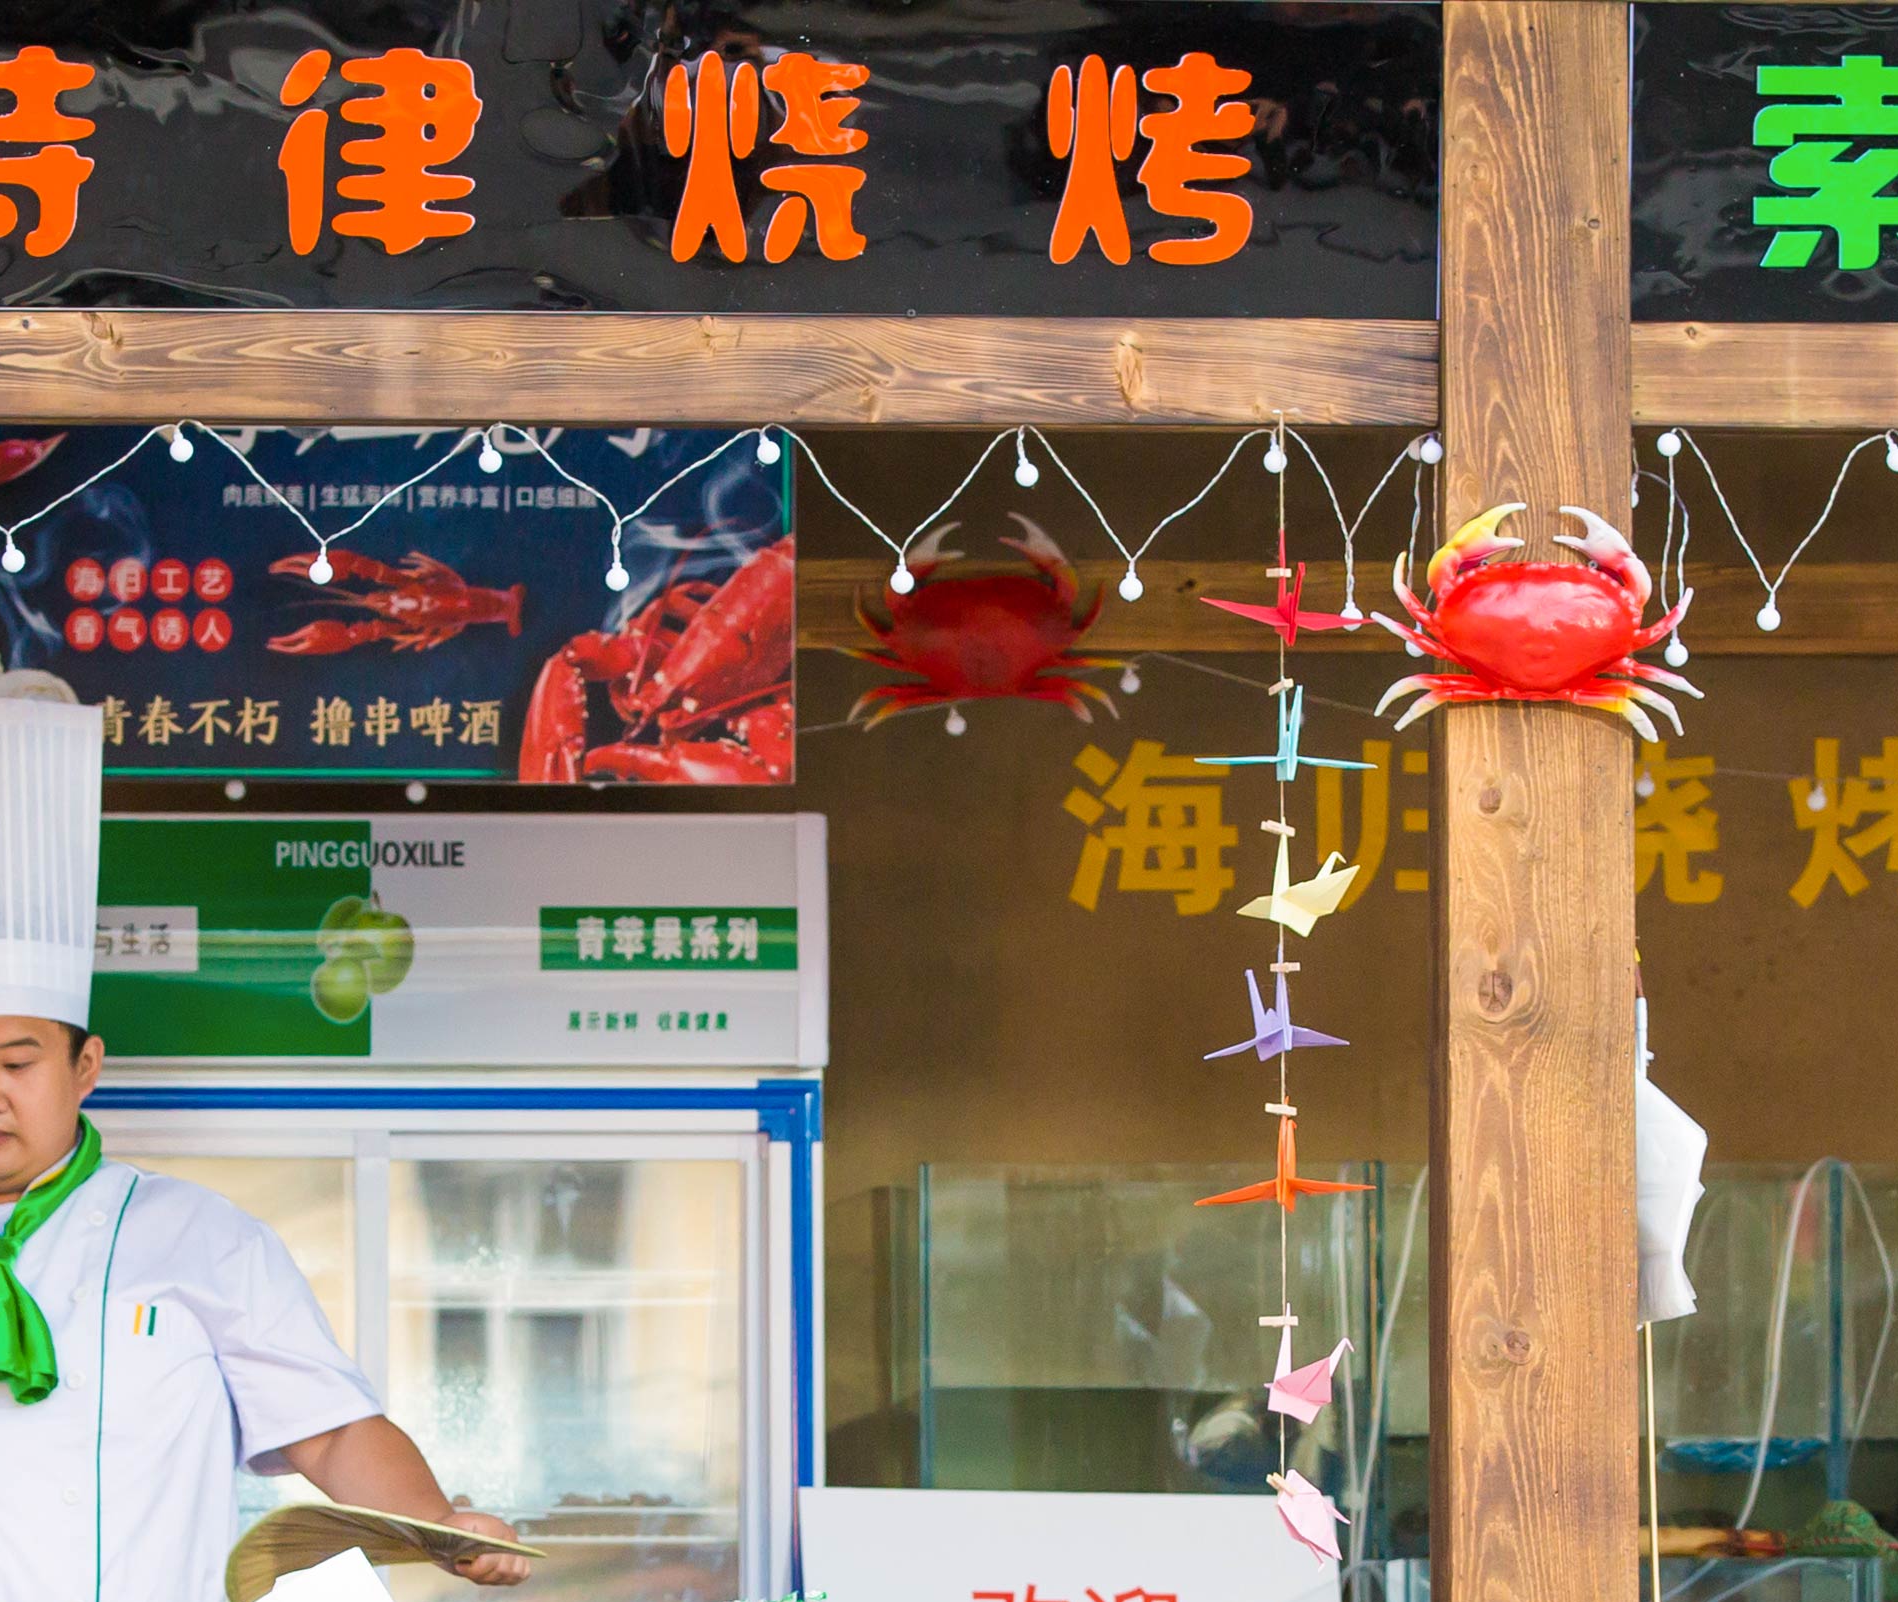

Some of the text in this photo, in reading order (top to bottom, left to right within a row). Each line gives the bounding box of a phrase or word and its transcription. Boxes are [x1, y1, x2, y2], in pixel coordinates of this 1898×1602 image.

[309, 695, 501, 747] 撸串啤酒
[275, 841, 465, 868] PINGGUOXILIE
[576, 916, 758, 960] 青苹果系列
